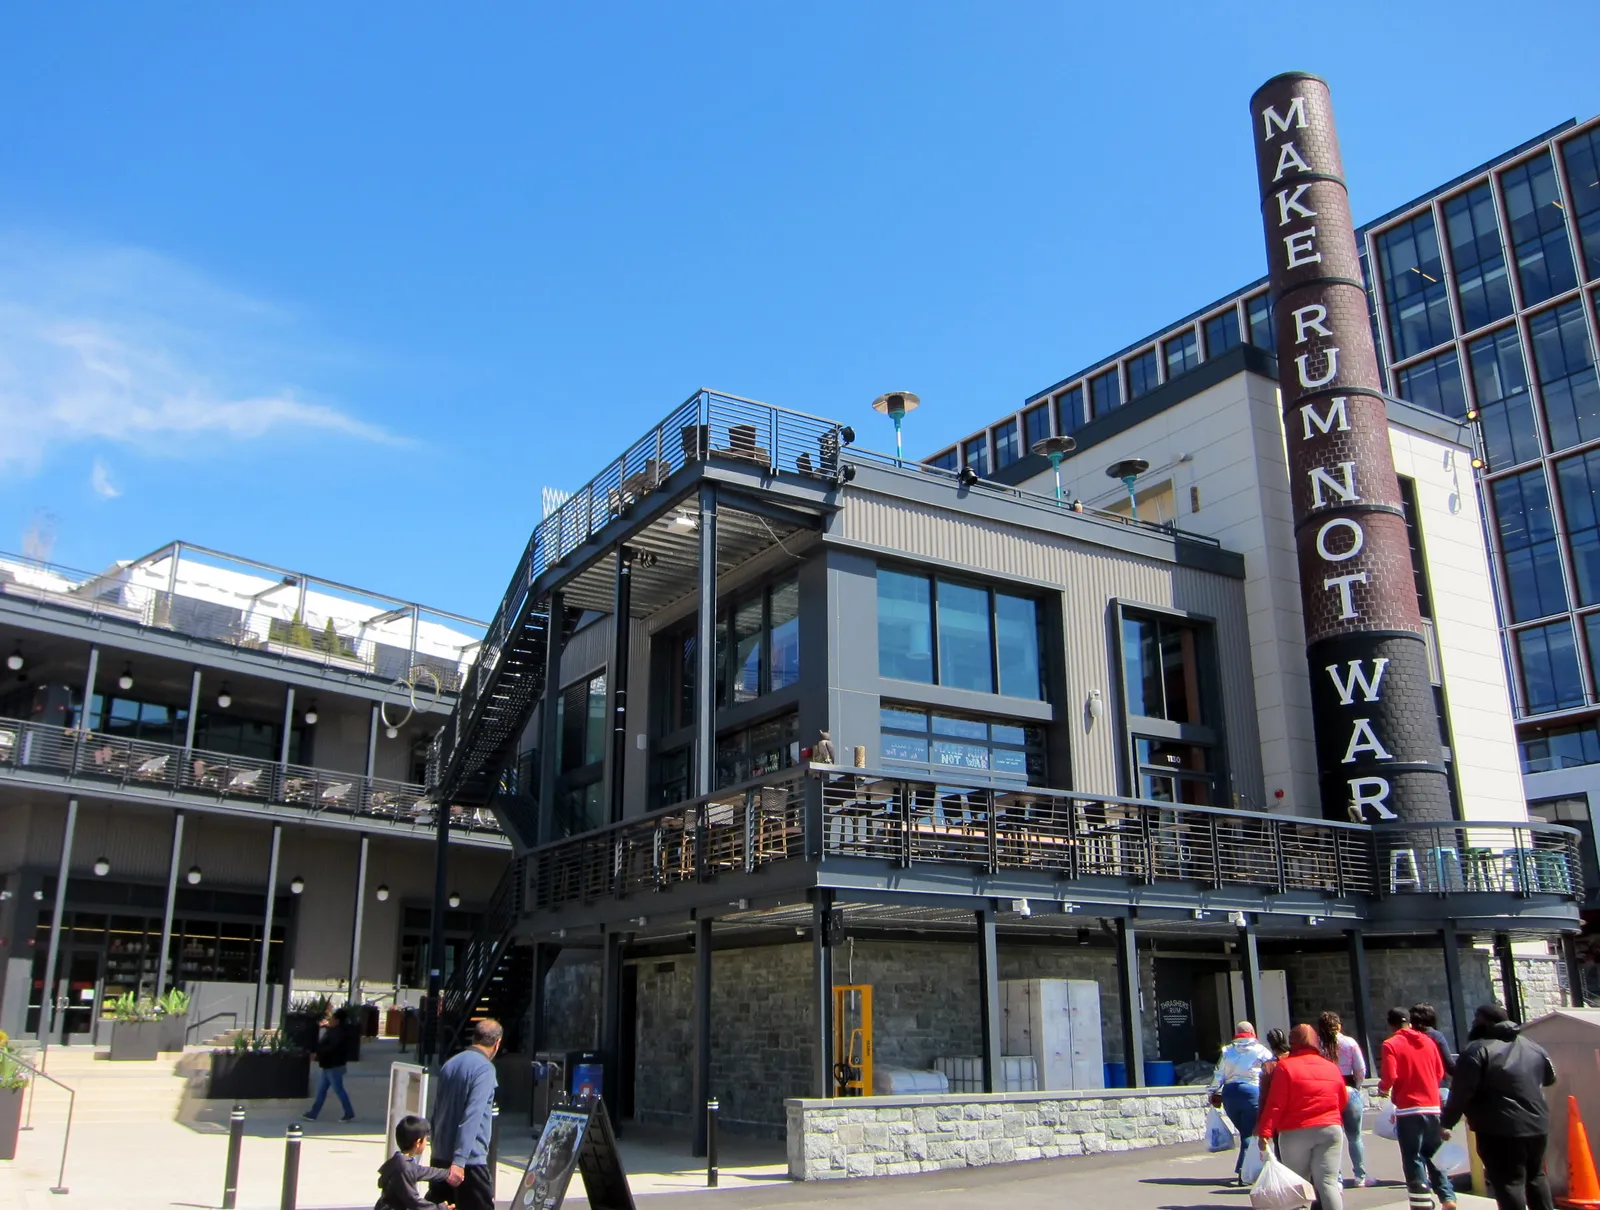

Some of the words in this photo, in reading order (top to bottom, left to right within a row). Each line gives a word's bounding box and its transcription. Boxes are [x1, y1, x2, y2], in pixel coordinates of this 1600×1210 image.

[1262, 97, 1321, 270] MAKE
[1291, 304, 1351, 440] RUM
[1308, 461, 1367, 619] NOT
[941, 754, 962, 765] NOT
[1325, 658, 1398, 821] WAR
